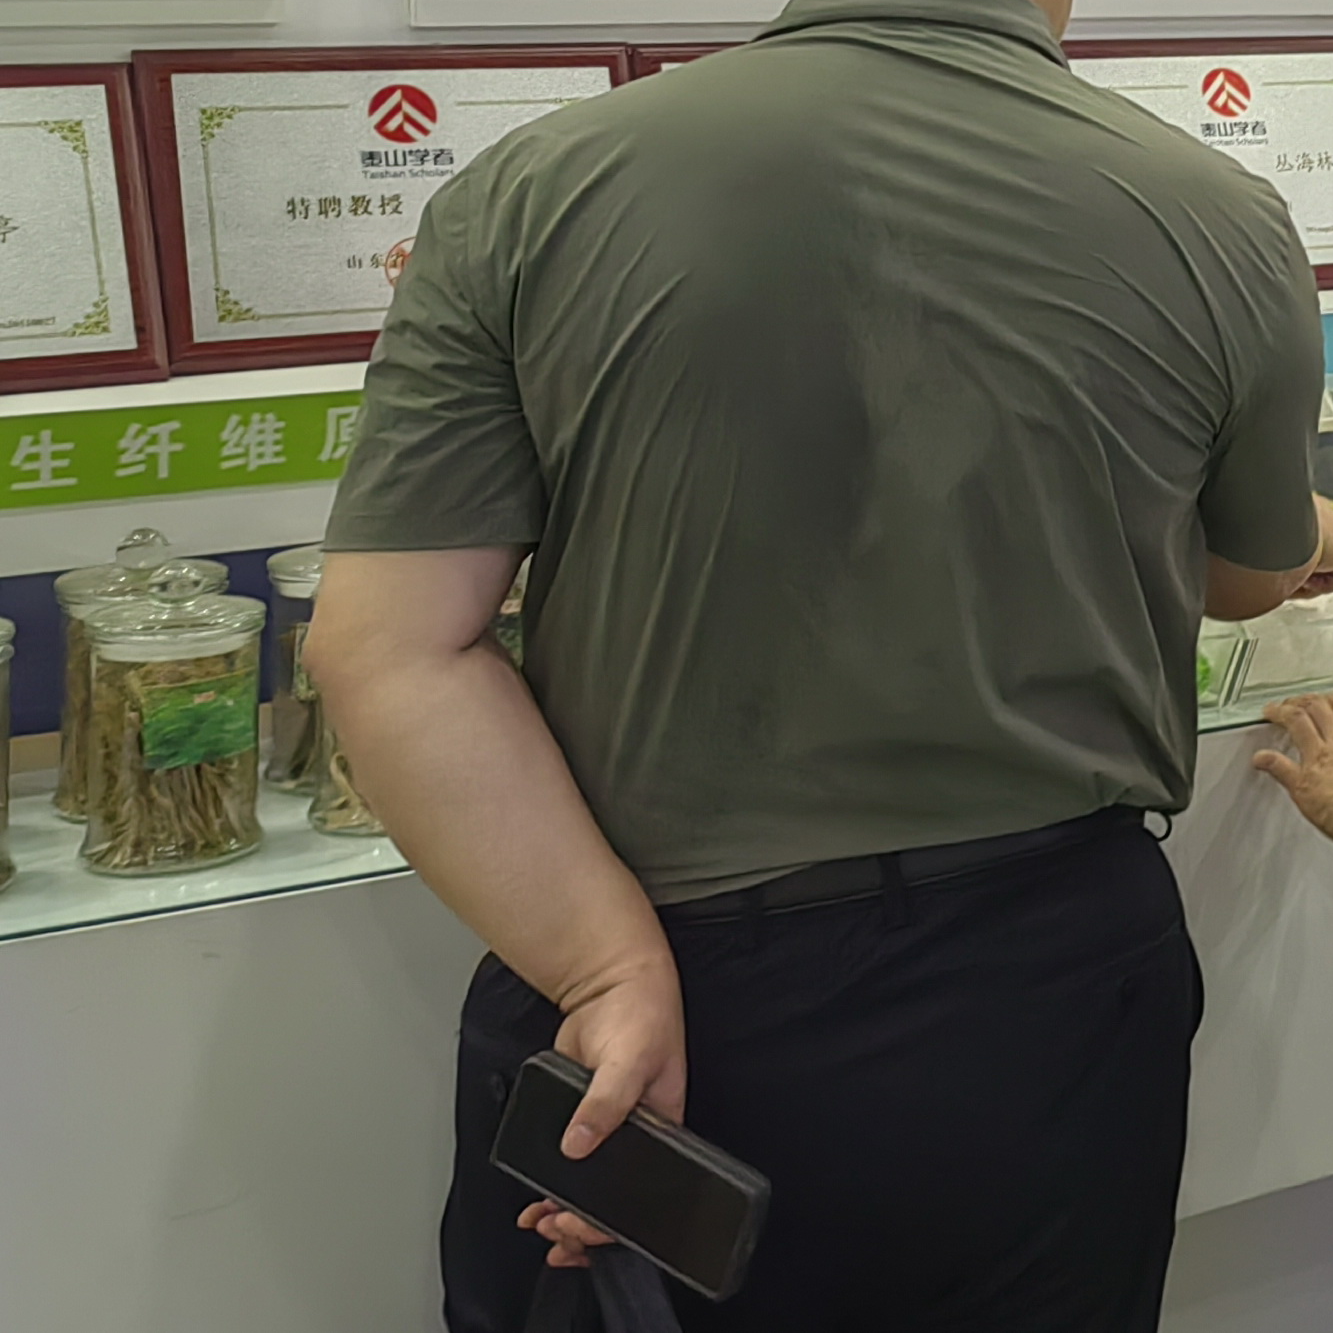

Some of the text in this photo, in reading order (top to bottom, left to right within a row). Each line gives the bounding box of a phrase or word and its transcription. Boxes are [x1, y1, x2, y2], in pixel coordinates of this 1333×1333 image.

[360, 148, 454, 168] 泰山学者
[286, 192, 404, 221] 特聘教授
